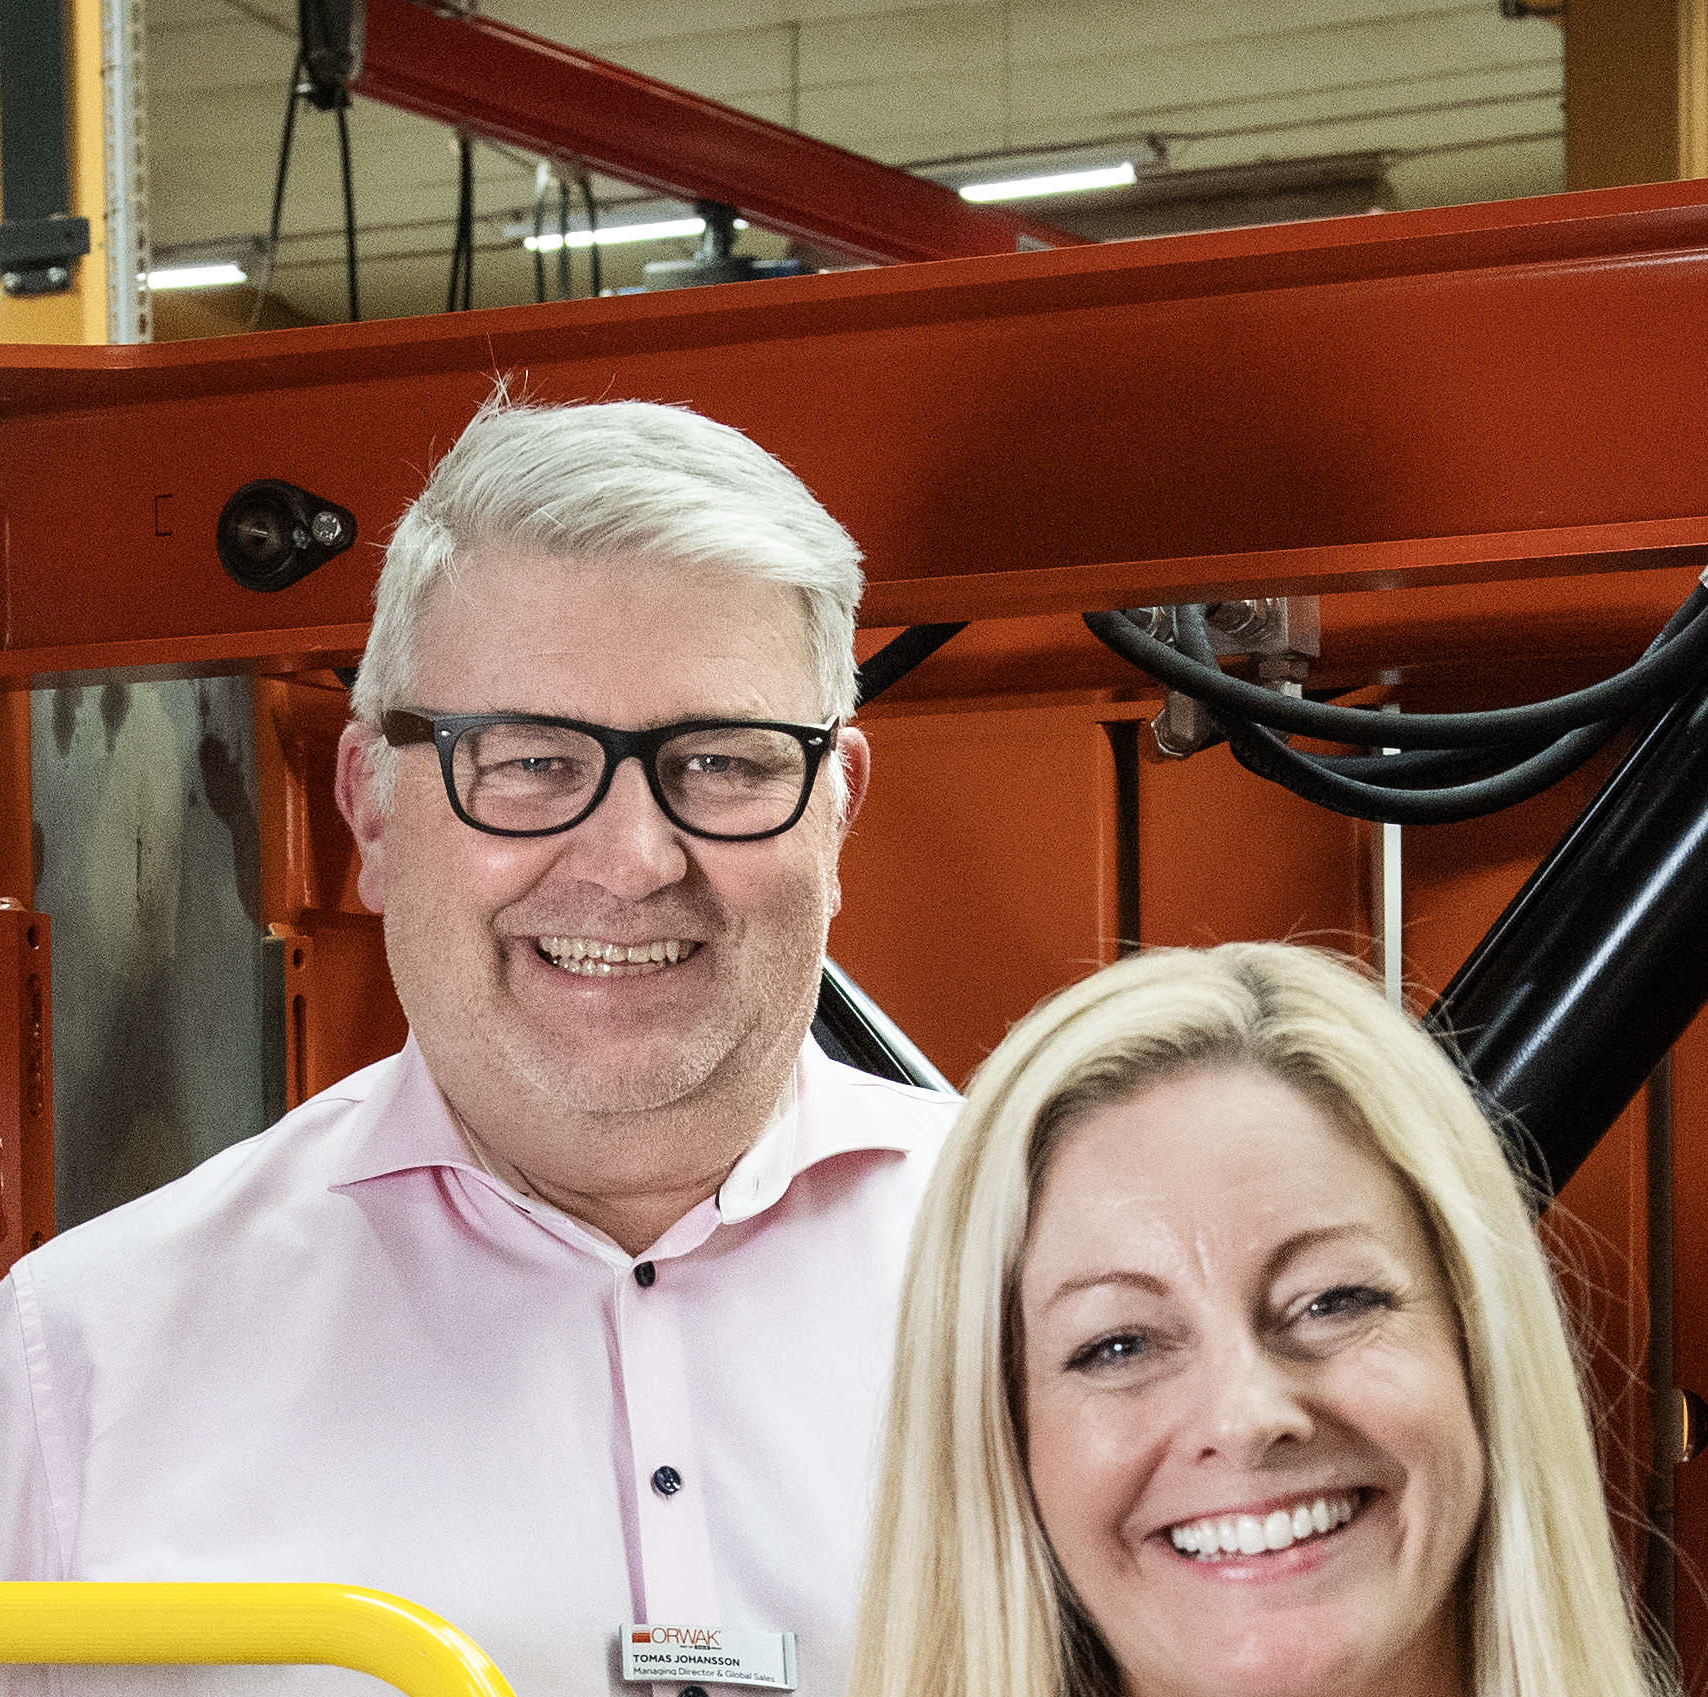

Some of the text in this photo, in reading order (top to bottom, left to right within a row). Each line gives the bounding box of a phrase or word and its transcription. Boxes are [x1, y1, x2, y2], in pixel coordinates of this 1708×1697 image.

[651, 1627, 721, 1646] ORWAK
[633, 1654, 741, 1667] TOMAS JOHANSSON
[633, 1667, 776, 1682] Managing Director & Global Sales
